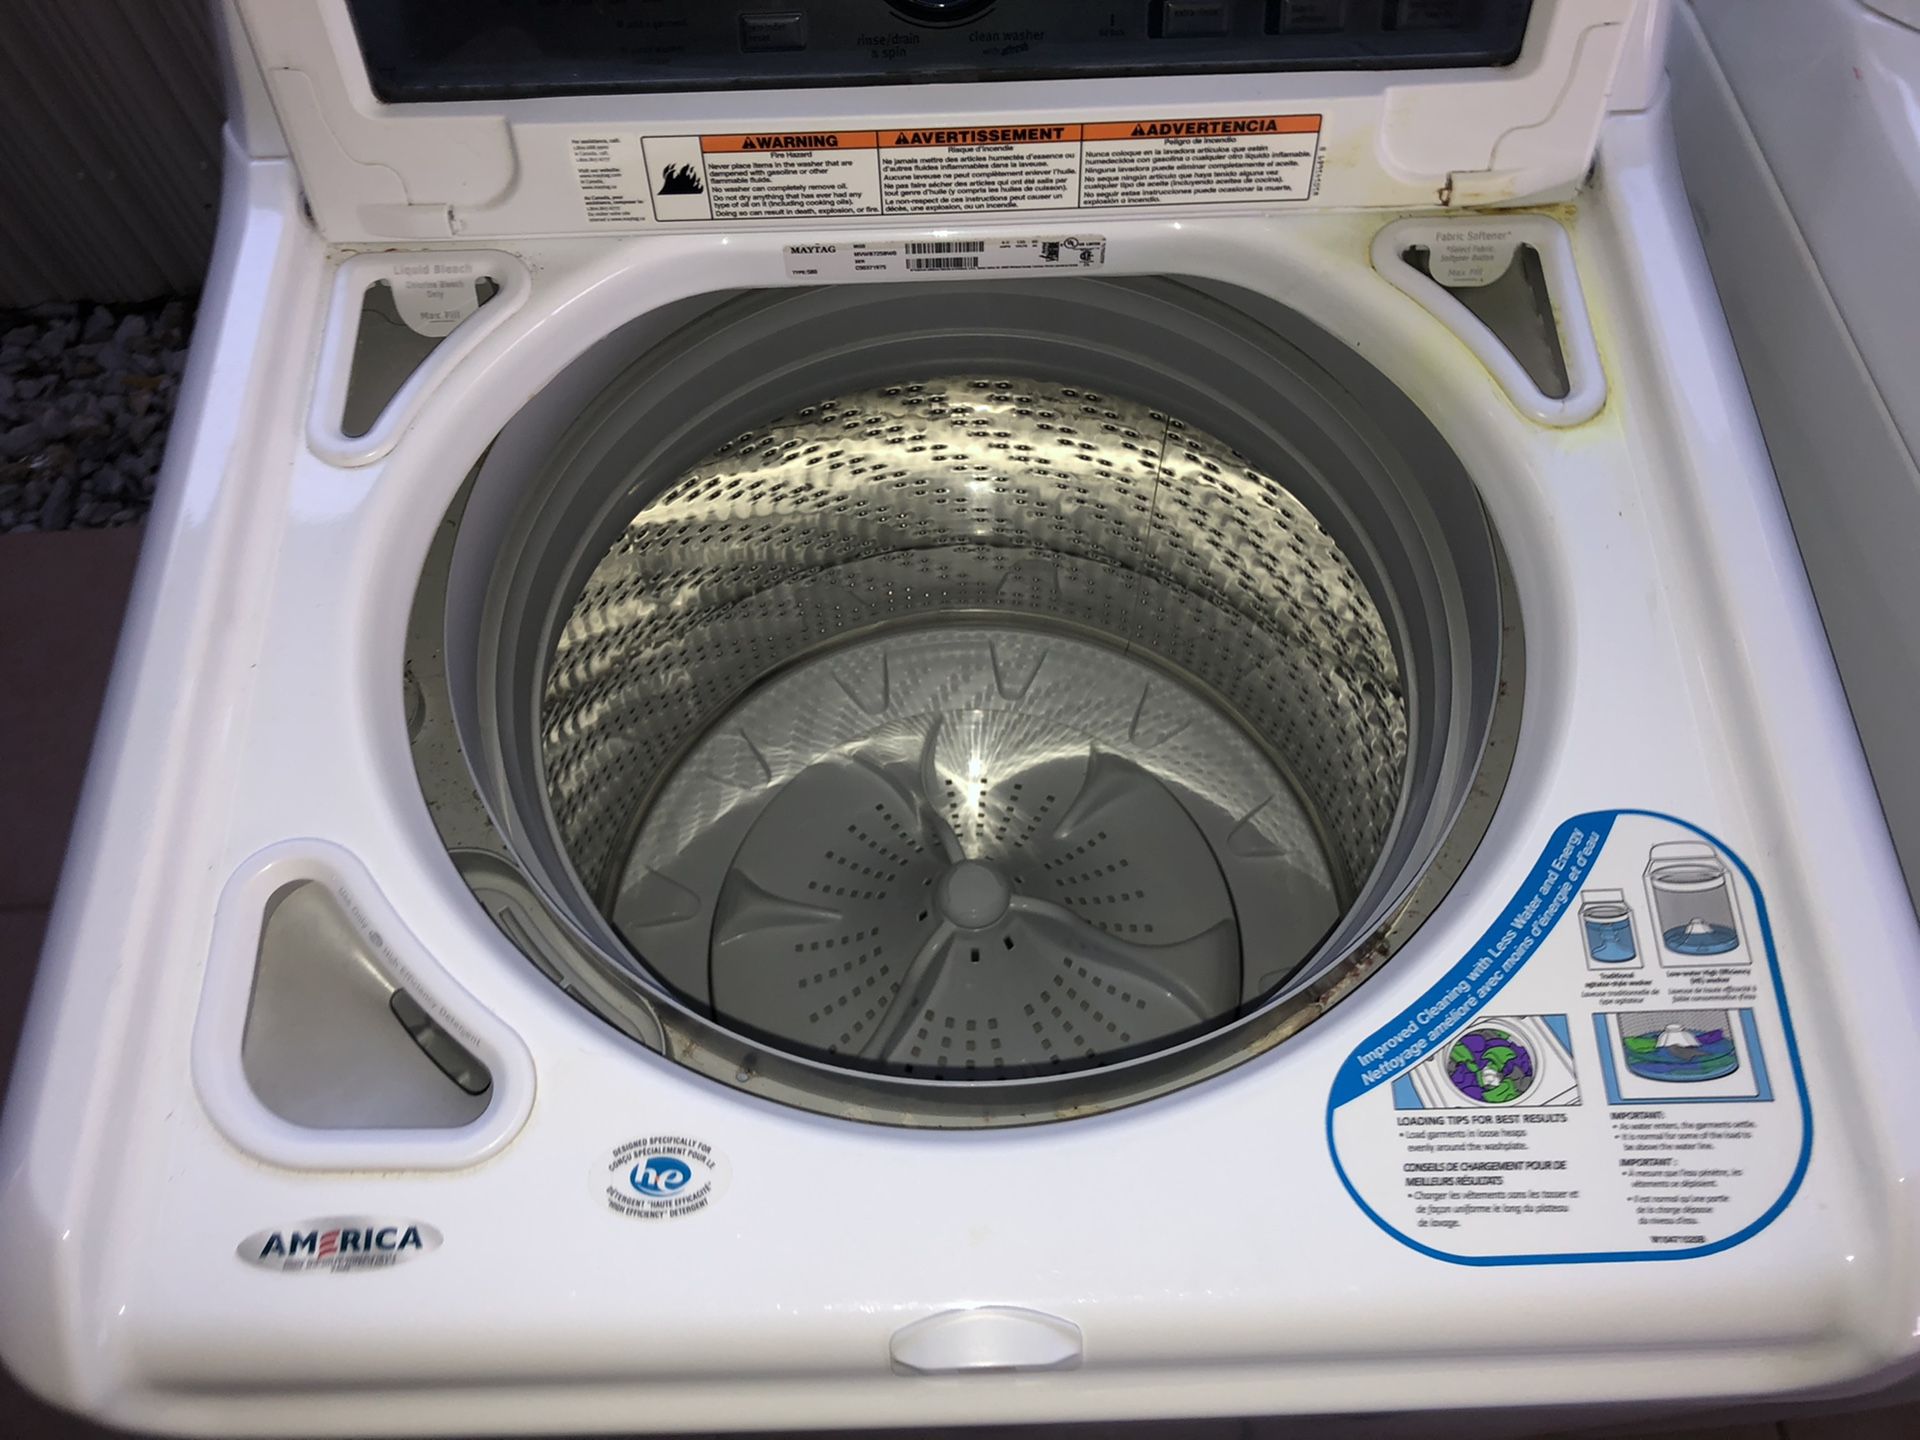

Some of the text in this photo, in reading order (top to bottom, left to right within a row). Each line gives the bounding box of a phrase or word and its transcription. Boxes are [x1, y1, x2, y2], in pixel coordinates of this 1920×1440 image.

[857, 33, 920, 47] rinse/drain
[969, 29, 1045, 42] clean washer
[882, 47, 906, 60] spin
[1147, 120, 1278, 136] ADVERTENCIA
[756, 135, 838, 149] WARNING
[910, 128, 1064, 144] AVERTISSEMENT
[786, 150, 812, 158] Hazard
[732, 162, 752, 170] place
[767, 168, 798, 177] gasoline
[954, 171, 970, 179] peut
[767, 184, 806, 193] completely
[739, 194, 751, 202] dry
[752, 193, 783, 202] anything
[714, 201, 730, 209] type
[716, 209, 737, 218] Doing
[1436, 232, 1464, 241] Fabric
[790, 246, 836, 254] MAYTAG
[393, 265, 472, 275] Liquid Bleach
[444, 311, 461, 319] Fill
[1359, 828, 1585, 1067] Improved Cleaning with Less Water and Energy
[1362, 831, 1600, 1086] Nettoyage amélioré avec moins d'énergie et d'eau
[1397, 1113, 1568, 1126] LOADING TIPS FOR BEST RESULTS
[613, 1136, 712, 1157] DESIGNED SPECIFICALLY FOR
[608, 1153, 632, 1172] CONÇU
[688, 1149, 707, 1163] POUR
[706, 1159, 716, 1170] LE
[1404, 1160, 1567, 1172] CONSEILS DE CHARGEMENT POUR DE
[635, 1156, 684, 1191] he
[1406, 1177, 1453, 1186] MEILLEURS
[670, 1197, 709, 1217] DETERGENT
[260, 1225, 423, 1259] AMERICA
